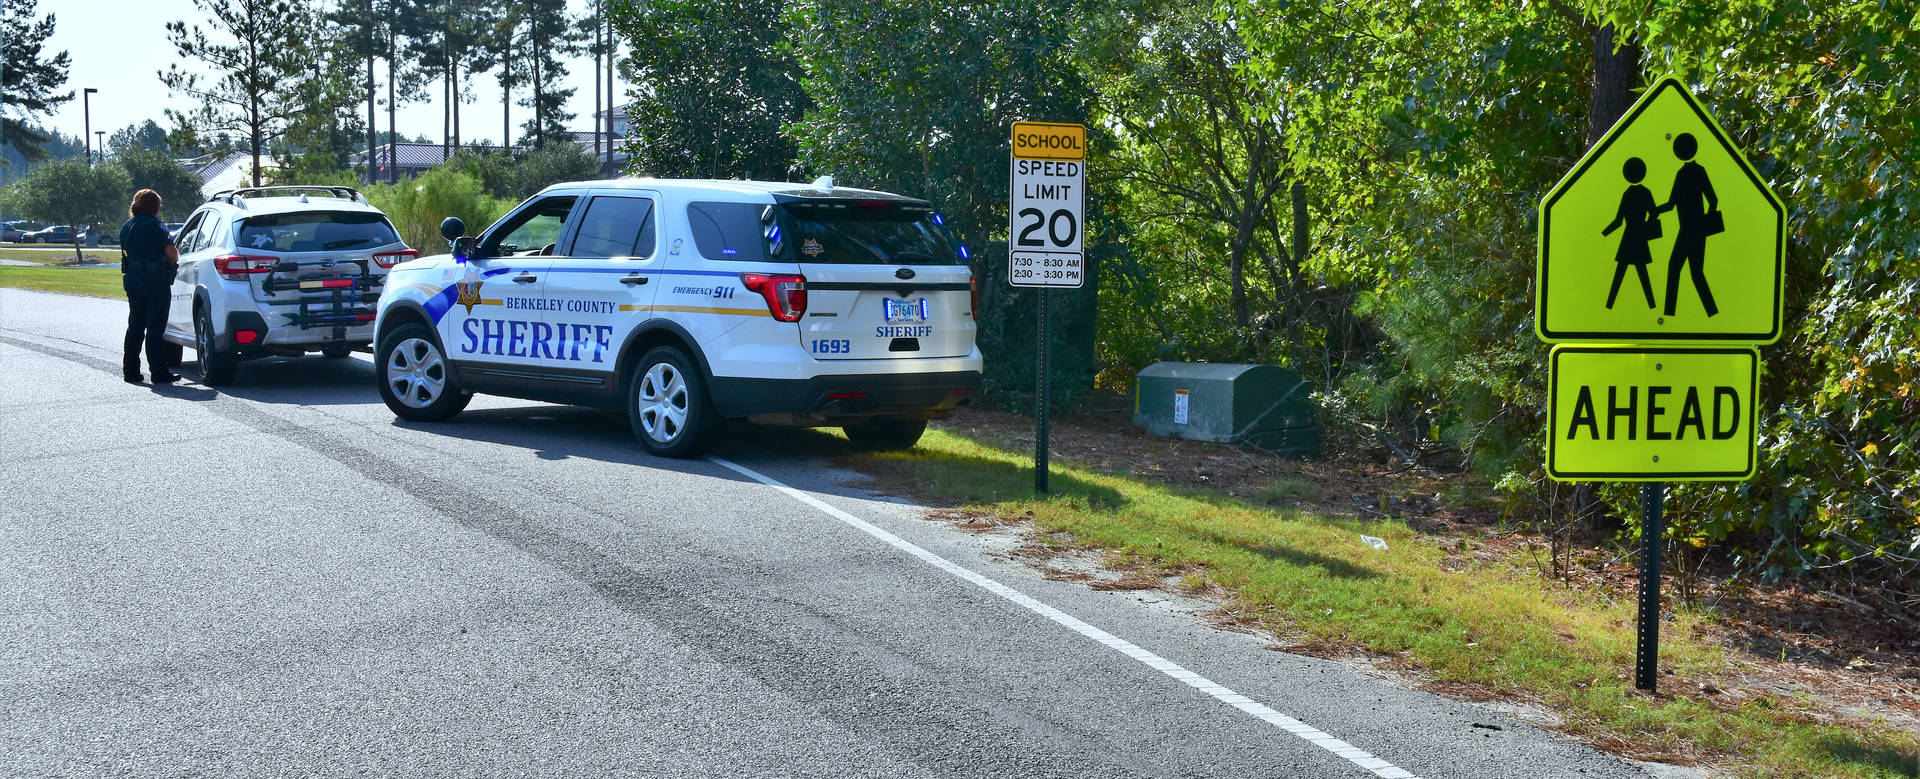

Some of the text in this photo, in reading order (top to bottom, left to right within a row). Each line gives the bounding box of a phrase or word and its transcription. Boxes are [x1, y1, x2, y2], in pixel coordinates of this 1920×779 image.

[1017, 134, 1081, 149] SCHOOL
[1018, 160, 1078, 177] SPEED
[1024, 184, 1071, 200] LIMIT
[1018, 207, 1077, 248] 20
[1014, 258, 1033, 266] 7:30
[1043, 259, 1063, 267] 8:30
[1014, 270, 1033, 278] 2:30
[1043, 271, 1063, 279] 3:30
[1066, 271, 1079, 279] PM
[672, 286, 735, 299] EMERGENCY 911
[506, 297, 616, 314] BERKELEY COUNTY
[876, 326, 932, 337] SHERIFF
[461, 318, 613, 363] SHERIFF
[812, 340, 850, 353] 1693
[1566, 385, 1741, 440] AHEAD
